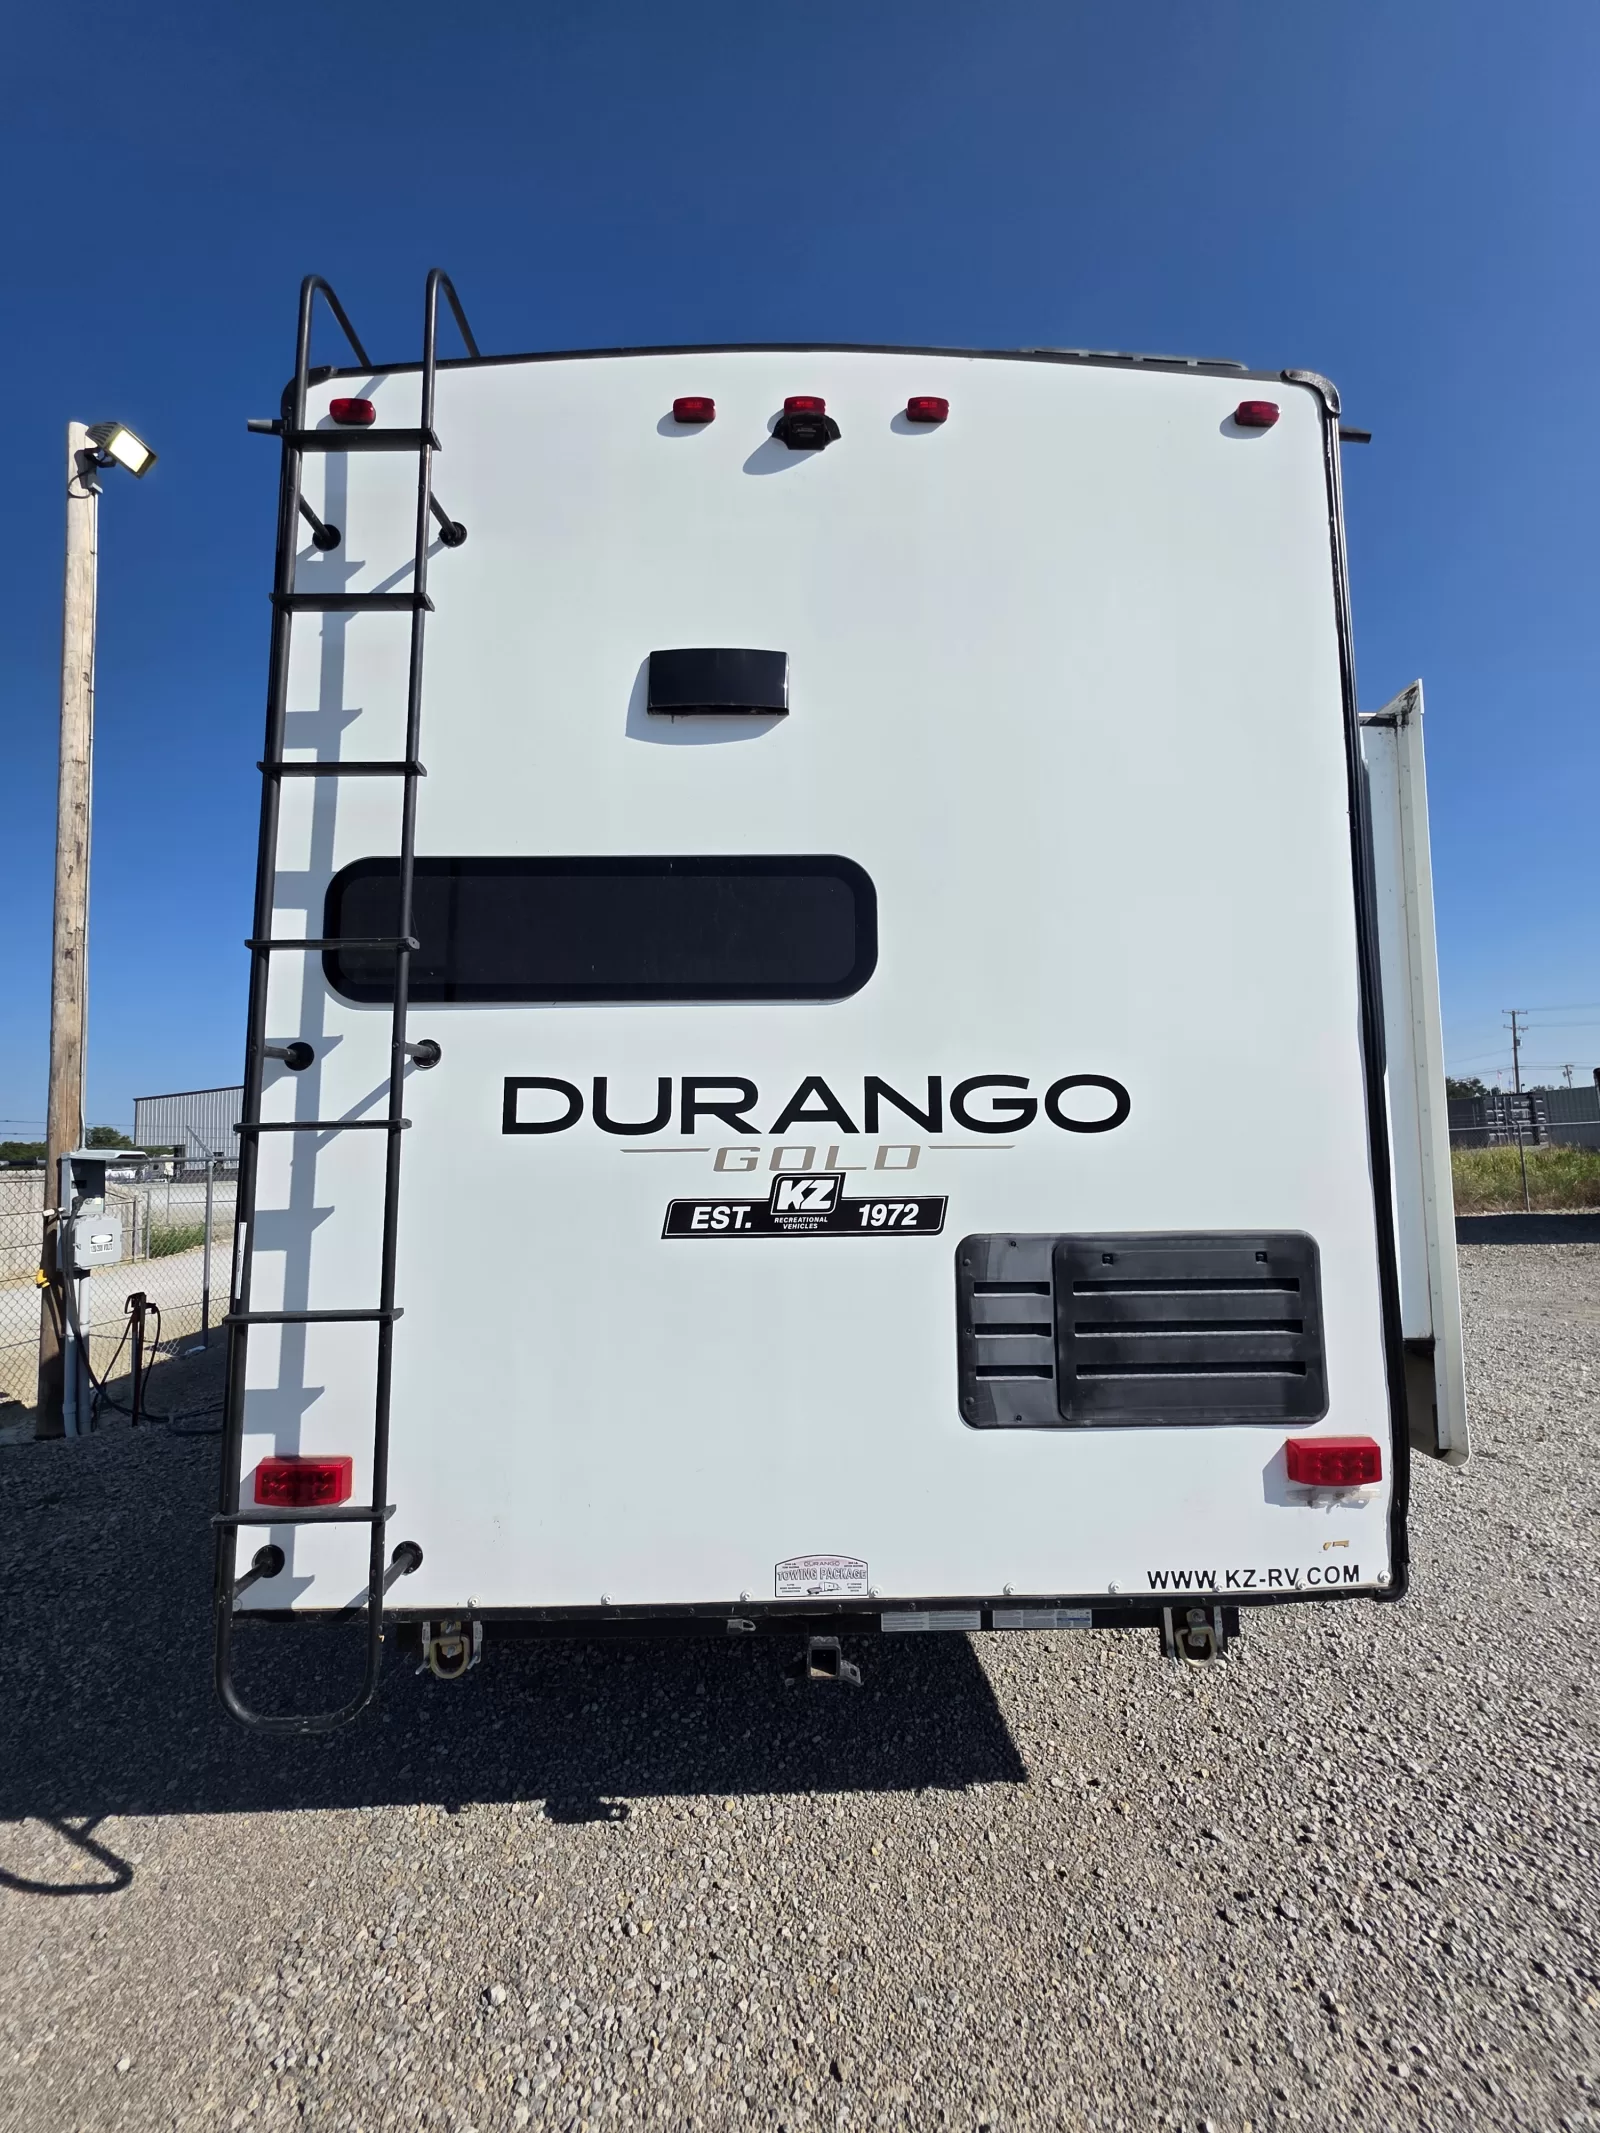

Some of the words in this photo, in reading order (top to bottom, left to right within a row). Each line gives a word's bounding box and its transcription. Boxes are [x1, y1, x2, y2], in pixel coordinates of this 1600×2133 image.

[502, 1074, 1131, 1135] DURANGO
[713, 1144, 921, 1172] GOLD
[777, 1179, 835, 1210] KZ
[691, 1206, 752, 1230] EST.
[774, 1216, 828, 1224] RECREATIONAL
[858, 1203, 919, 1227] 1972
[777, 1567, 817, 1581] TOWING
[820, 1567, 866, 1580] PACKAGE
[1147, 1565, 1360, 1590] WWWKZ-RVCOM
